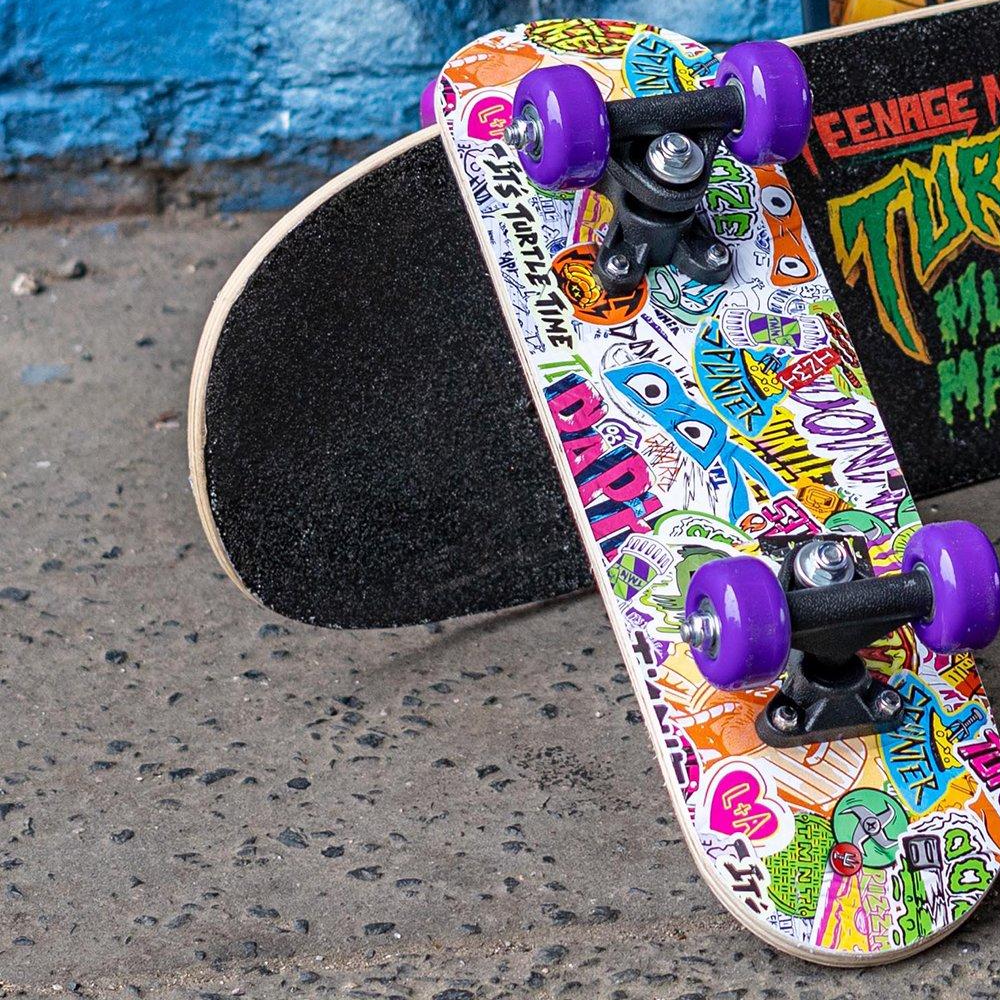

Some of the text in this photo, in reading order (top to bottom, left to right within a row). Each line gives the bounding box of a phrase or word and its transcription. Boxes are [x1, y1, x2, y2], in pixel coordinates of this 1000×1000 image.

[635, 34, 676, 97] SPLINT
[803, 80, 979, 178] EENAGE
[502, 202, 551, 288] TURTLE
[534, 290, 574, 350] TIME
[702, 325, 764, 432] SPLINTER
[723, 858, 769, 914] IT'
[796, 824, 814, 910] TMNT
